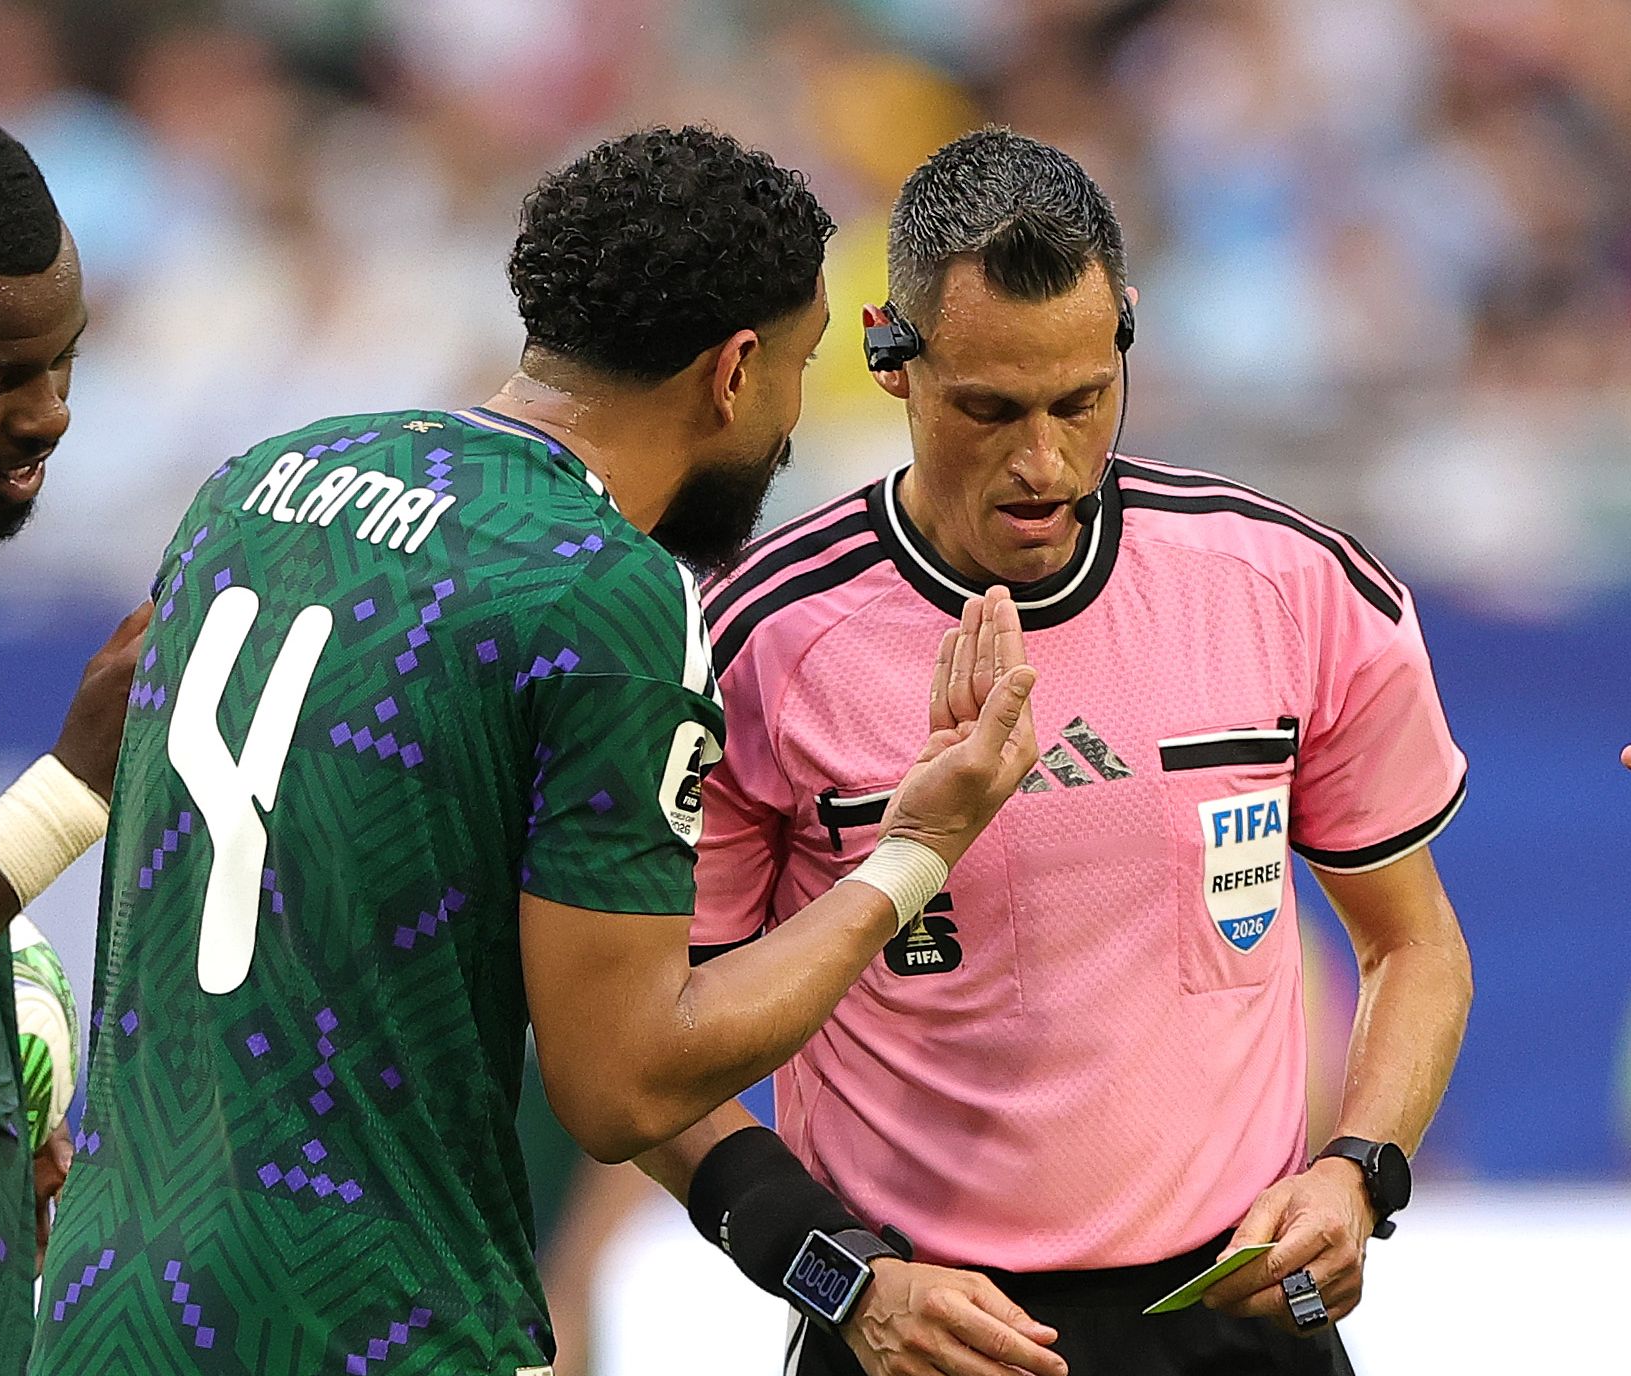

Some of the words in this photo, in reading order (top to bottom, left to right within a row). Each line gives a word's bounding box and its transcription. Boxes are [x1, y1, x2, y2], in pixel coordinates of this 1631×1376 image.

[241, 451, 457, 554] ALAMRI
[167, 586, 334, 995] 4
[1211, 798, 1283, 848] FIFA
[1211, 861, 1281, 894] REFEREE
[1231, 917, 1264, 940] 2026
[906, 949, 944, 966] FIFA
[795, 1251, 849, 1304] 00:00
